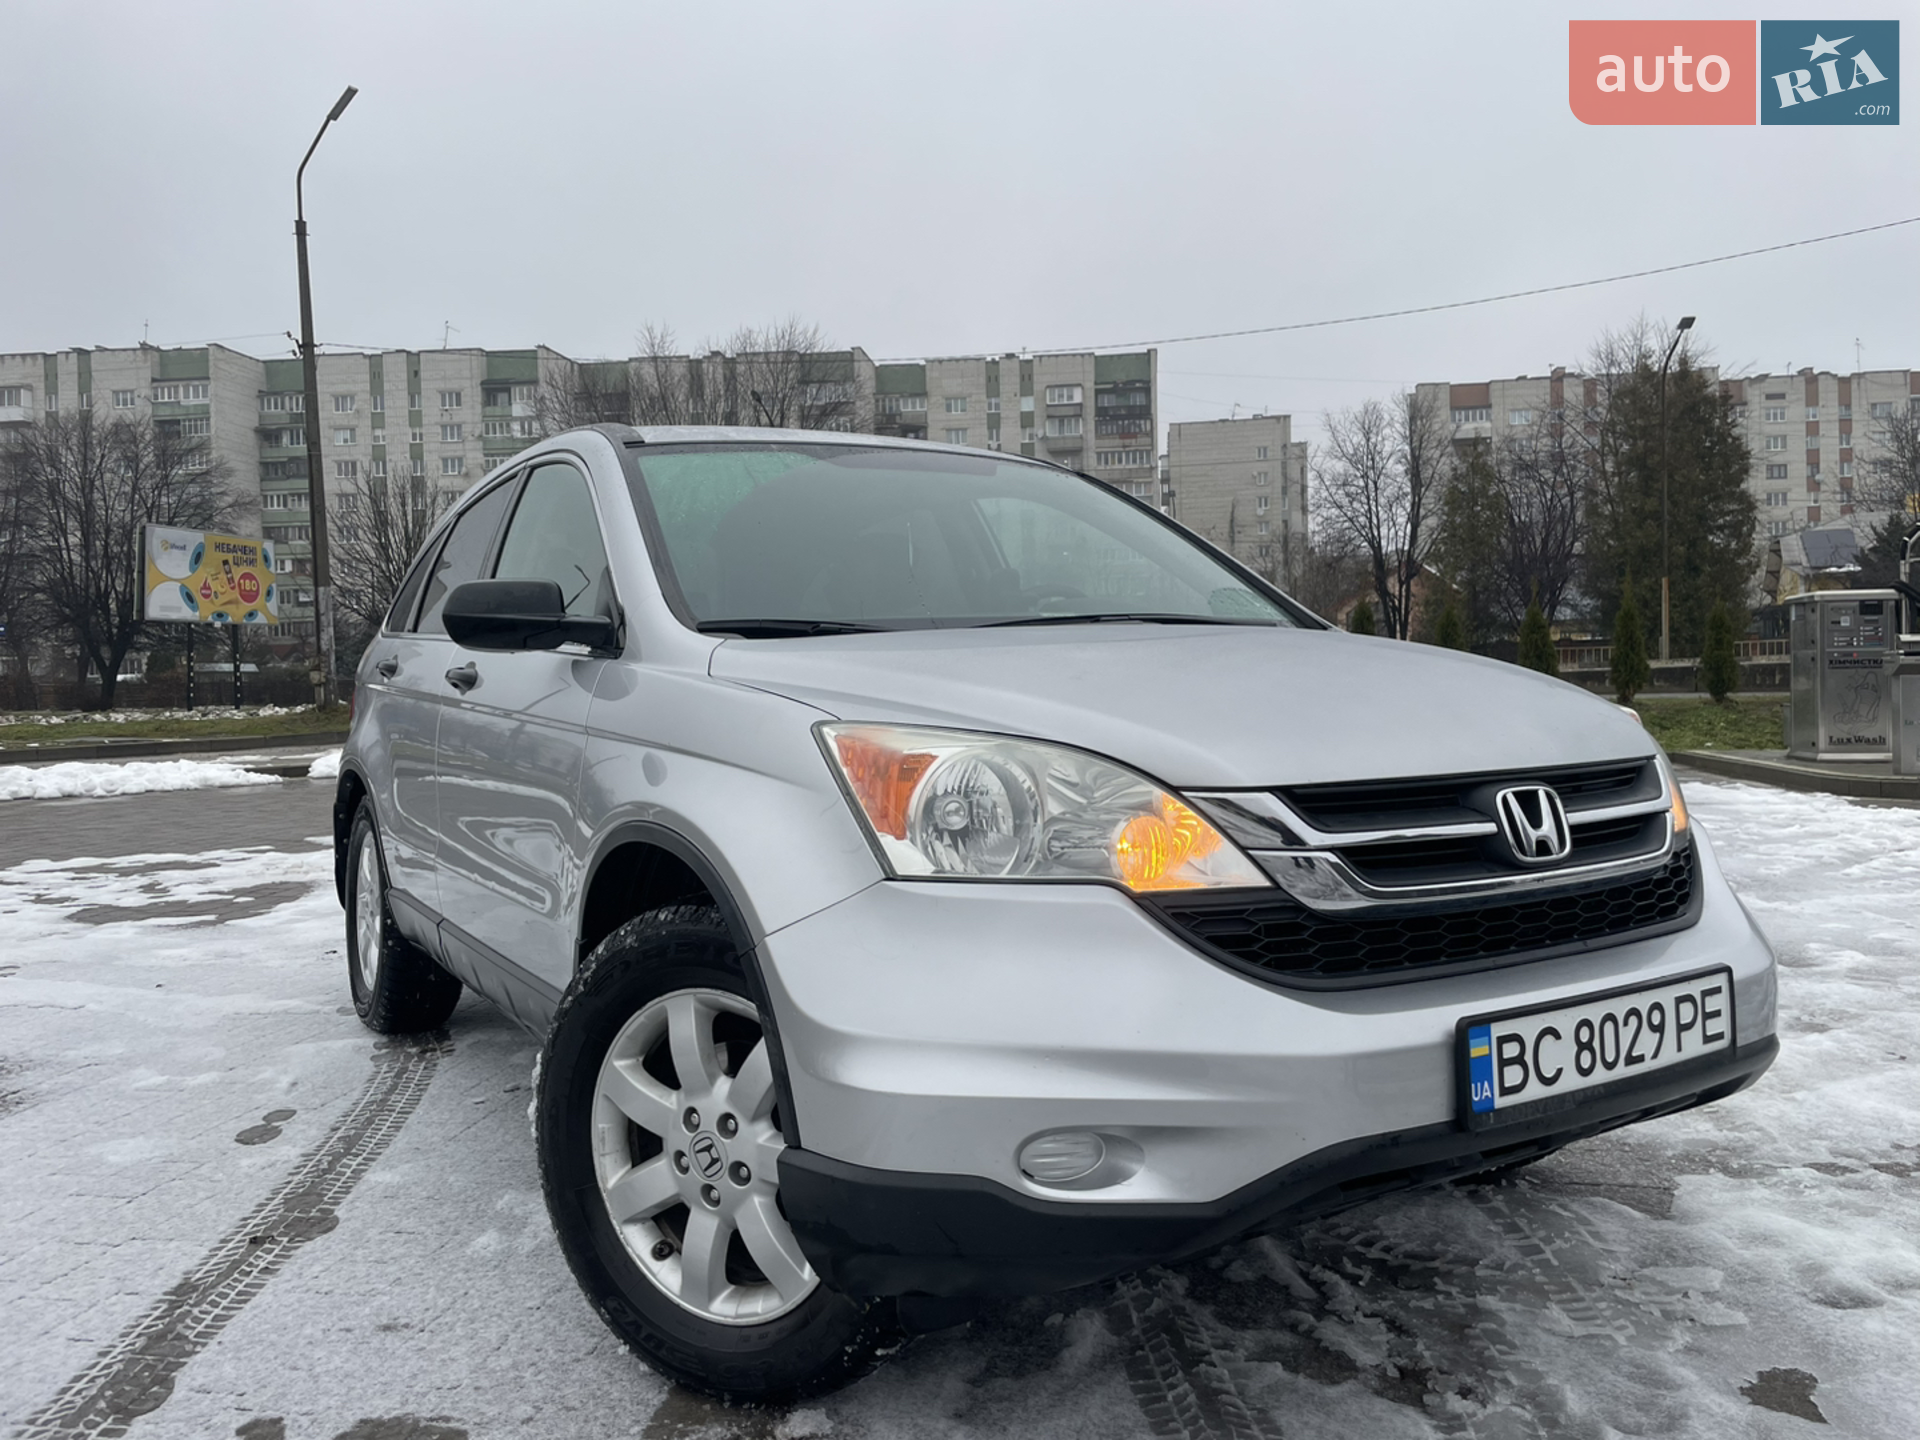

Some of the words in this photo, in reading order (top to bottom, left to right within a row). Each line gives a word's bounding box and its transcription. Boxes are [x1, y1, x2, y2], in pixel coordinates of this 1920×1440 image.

[214, 541, 257, 557] НЕБАЧЕНІ
[232, 555, 257, 568] ЦІНИ!
[1828, 735, 1887, 746] LuxWash
[1496, 1025, 1564, 1098] BC
[1574, 1001, 1666, 1078] 8029
[1674, 985, 1726, 1053] PE
[1471, 1080, 1492, 1101] UA
